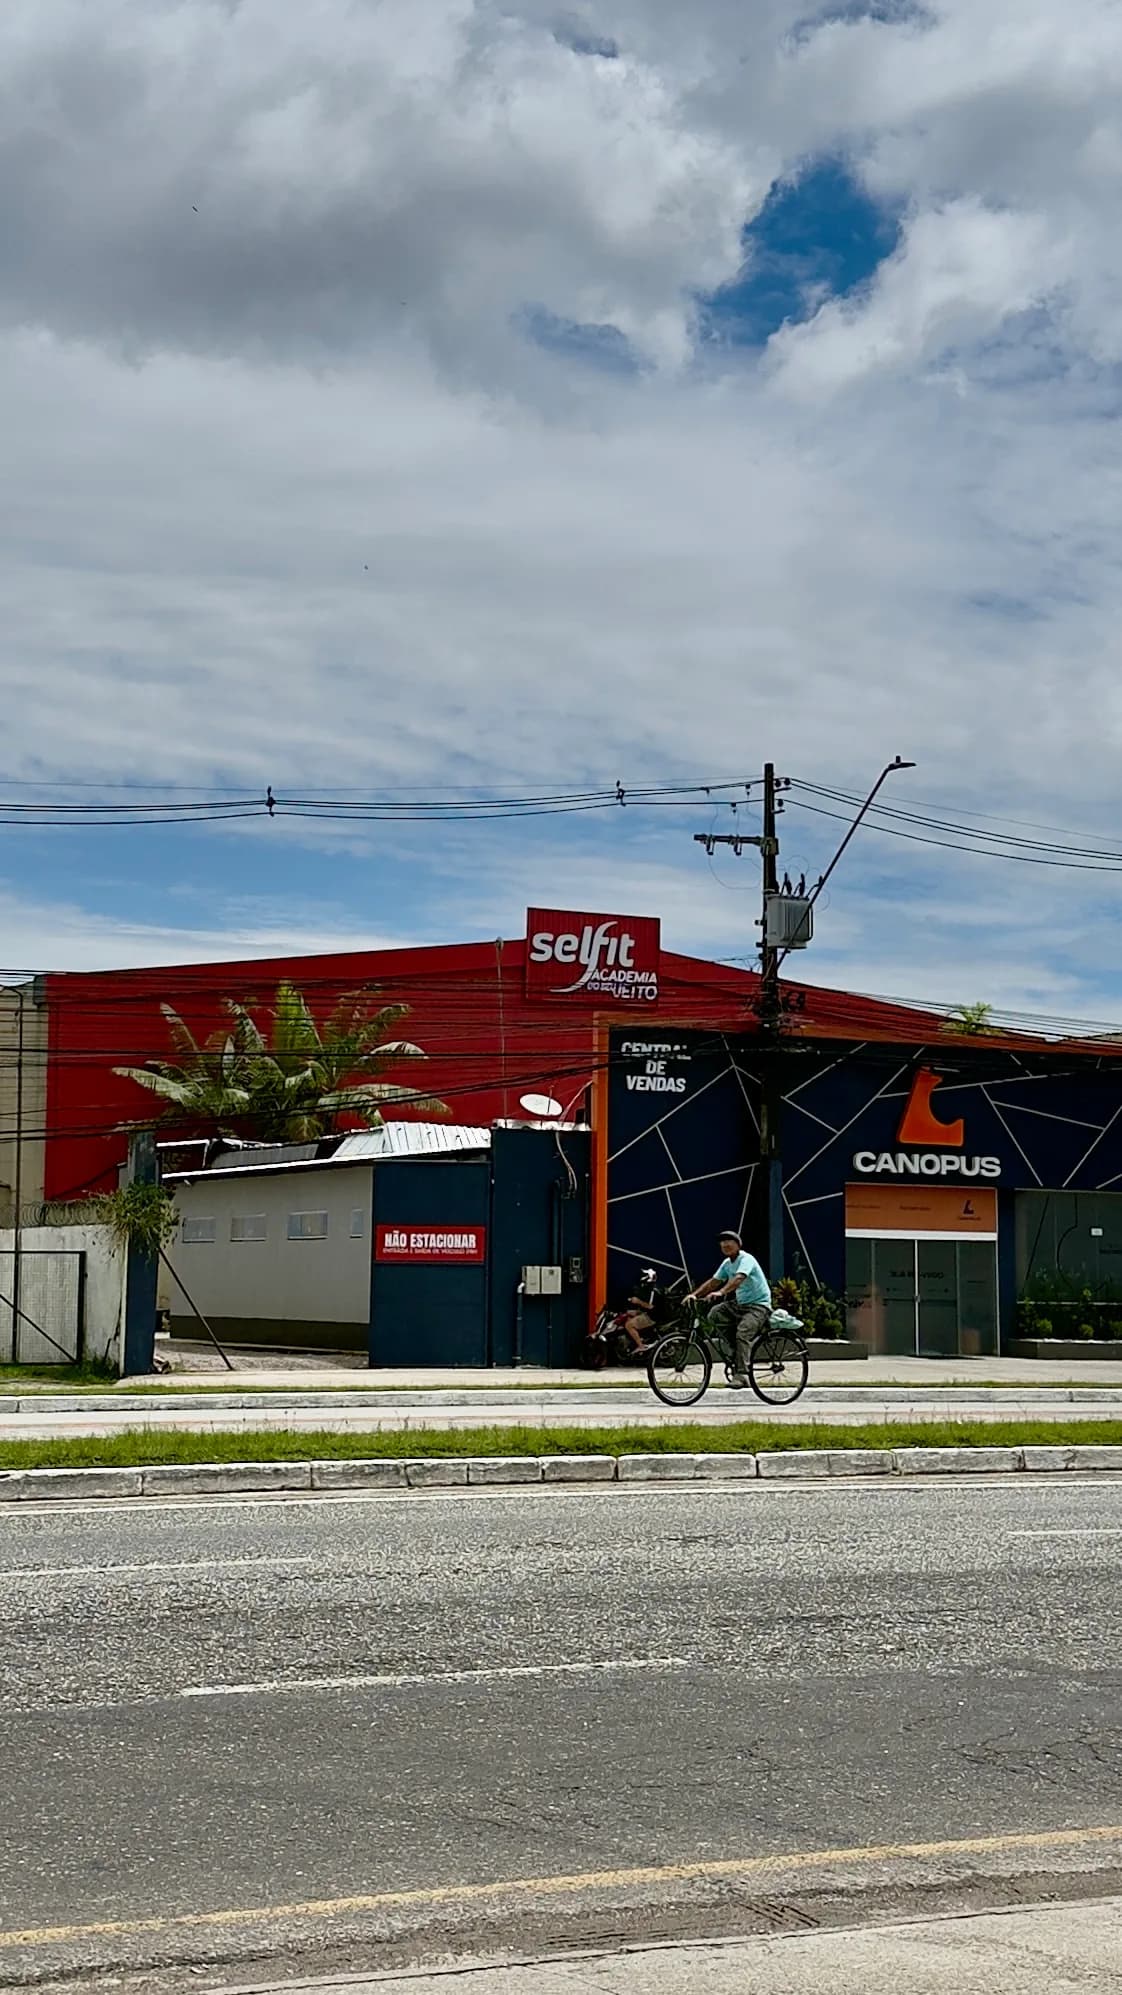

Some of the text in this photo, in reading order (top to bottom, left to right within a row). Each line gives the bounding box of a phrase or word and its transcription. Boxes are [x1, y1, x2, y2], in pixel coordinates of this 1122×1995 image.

[591, 968, 658, 984] ACADEMIA
[645, 1059, 667, 1075] DE
[625, 1074, 687, 1093] VENDAS
[853, 1150, 1002, 1178] CANOPUS
[384, 1229, 477, 1249] NÃO ESTACIONAR
